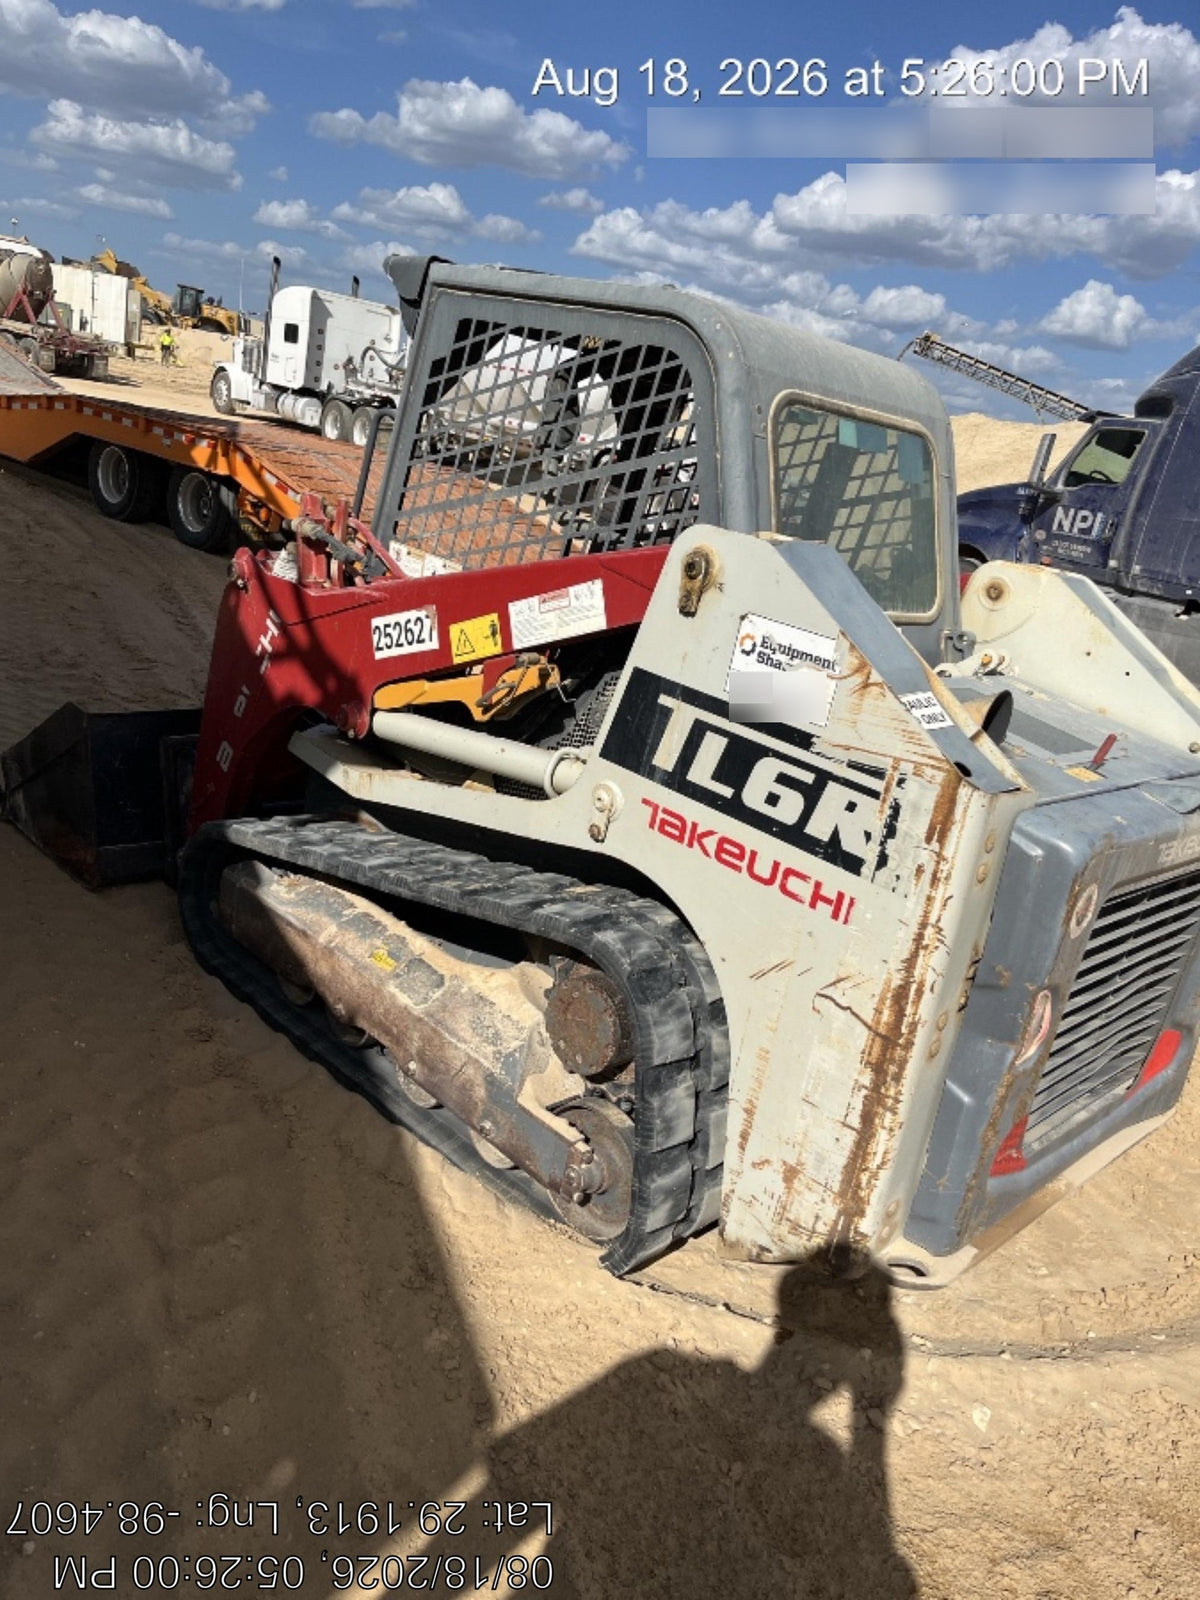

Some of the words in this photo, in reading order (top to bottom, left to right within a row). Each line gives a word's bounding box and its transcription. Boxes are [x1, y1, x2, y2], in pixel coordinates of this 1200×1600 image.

[756, 650, 793, 672] Sha
[759, 635, 838, 673] Equipment
[651, 694, 882, 862] TL6R
